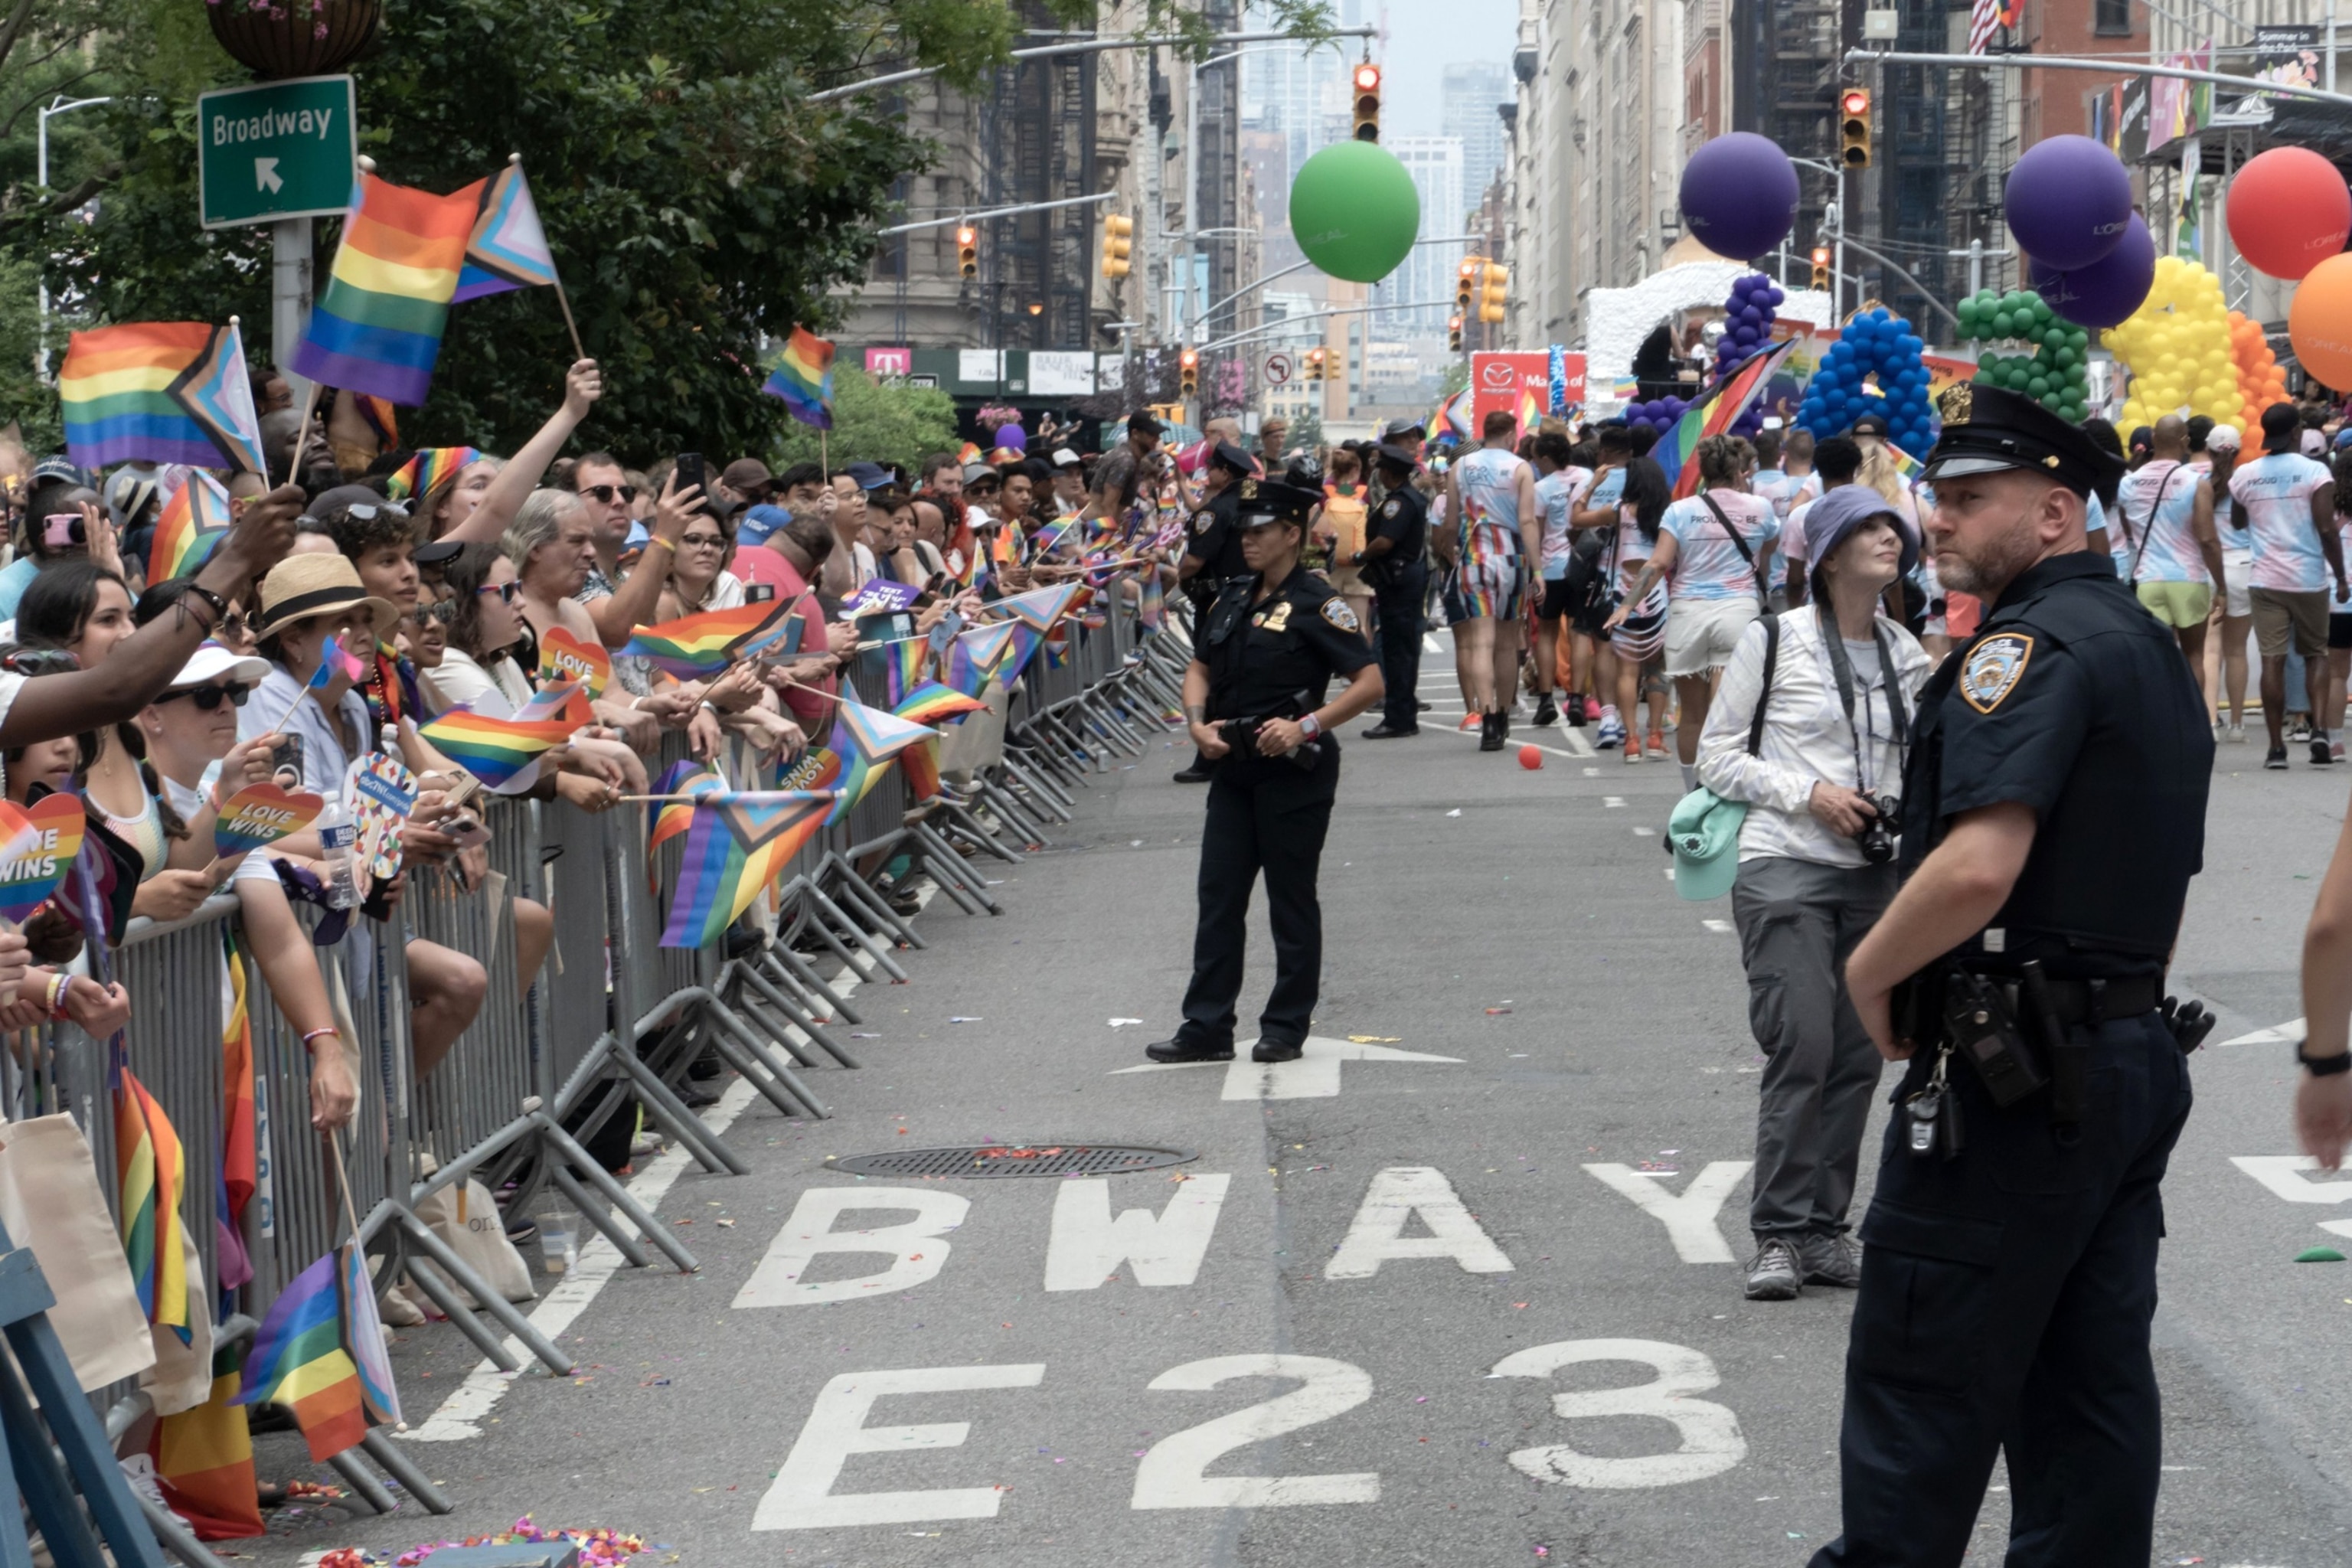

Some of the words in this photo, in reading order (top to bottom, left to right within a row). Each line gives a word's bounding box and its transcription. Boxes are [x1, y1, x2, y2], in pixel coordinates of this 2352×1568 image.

[213, 107, 332, 145] Broadway
[2247, 478, 2277, 486] PROUD
[2292, 475, 2303, 483] BE
[1746, 515, 1758, 524] BE
[880, 586, 903, 595] TEXT
[555, 649, 594, 675] LOVE
[781, 755, 816, 787] WINS
[240, 803, 296, 825] LOVE
[227, 818, 280, 839] WINS
[28, 828, 59, 853] VE
[750, 1364, 1047, 1530] E
